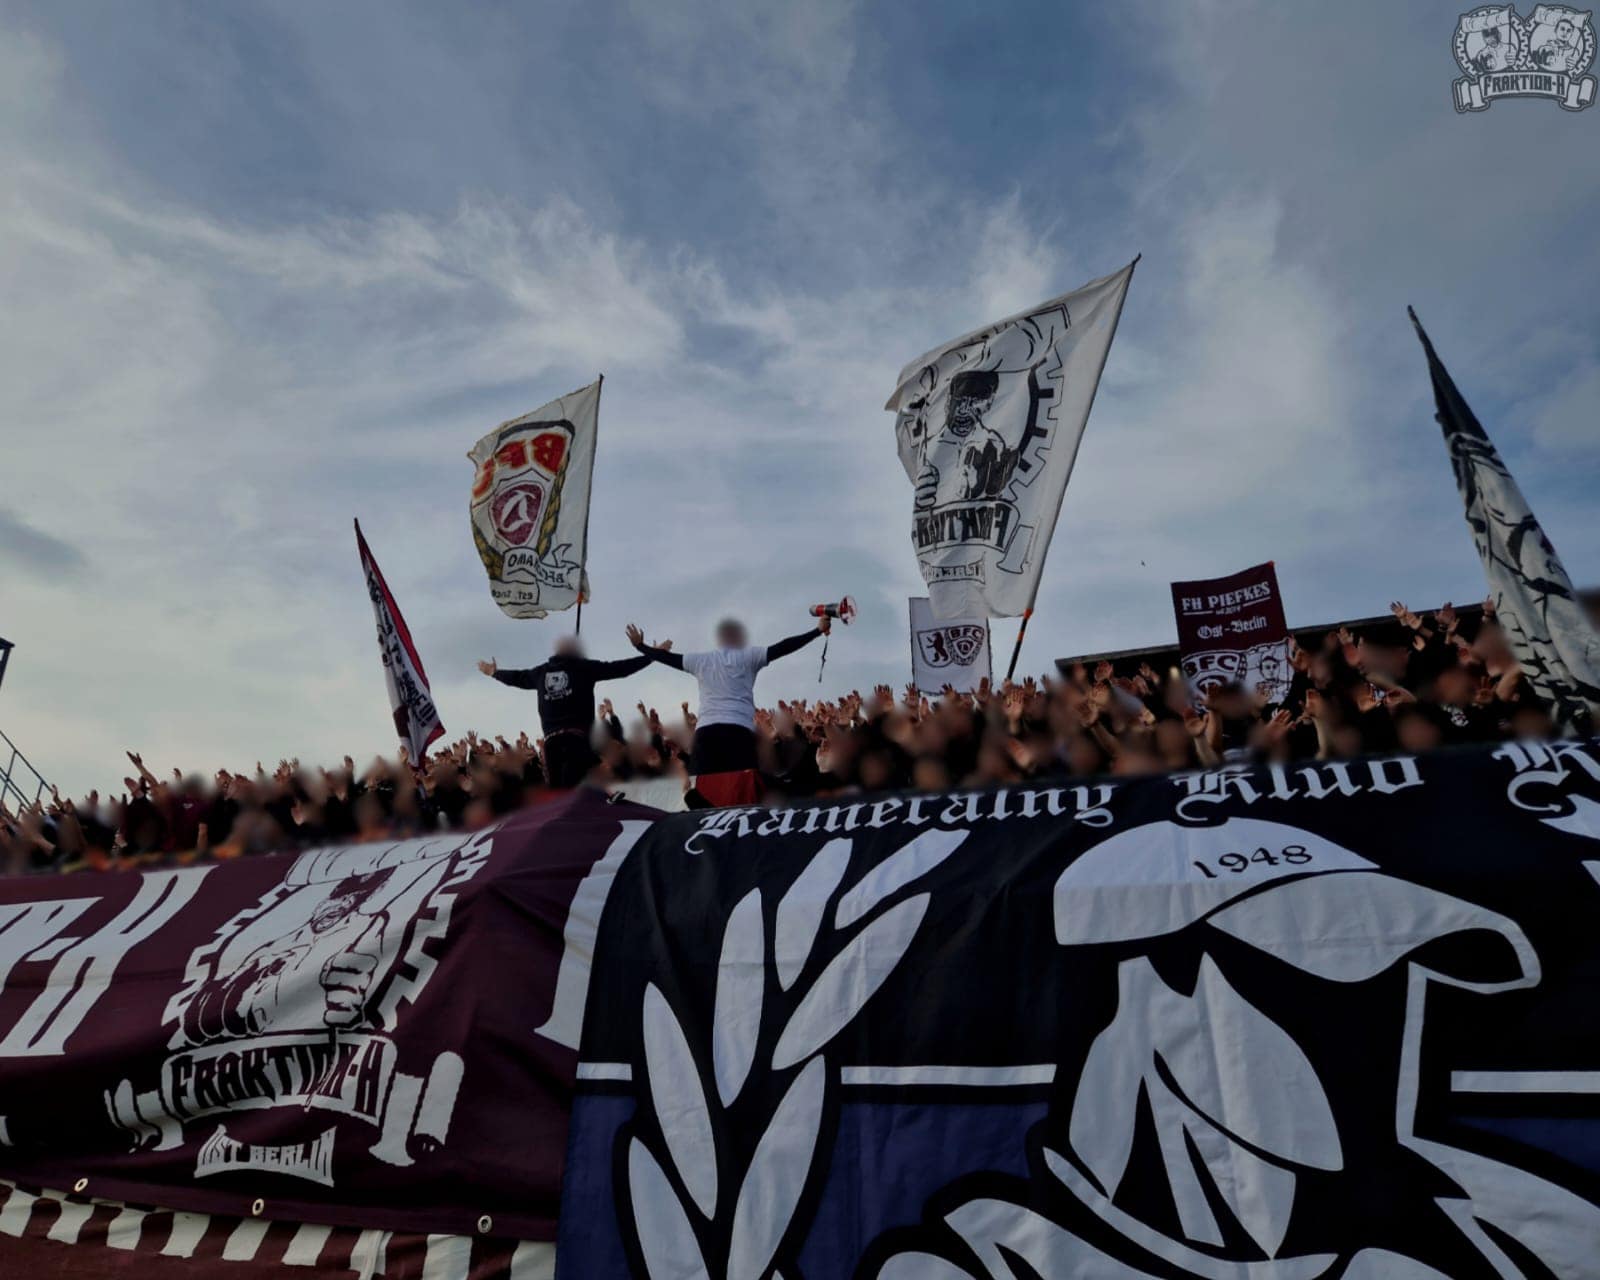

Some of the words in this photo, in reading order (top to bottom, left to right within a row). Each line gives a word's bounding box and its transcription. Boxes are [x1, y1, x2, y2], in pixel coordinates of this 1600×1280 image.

[1181, 596, 1206, 611] FH
[1207, 580, 1271, 609] PIEFKES
[1193, 845, 1313, 879] 1948
[197, 1126, 244, 1170] OST
[249, 1126, 338, 1181] BERLIN
